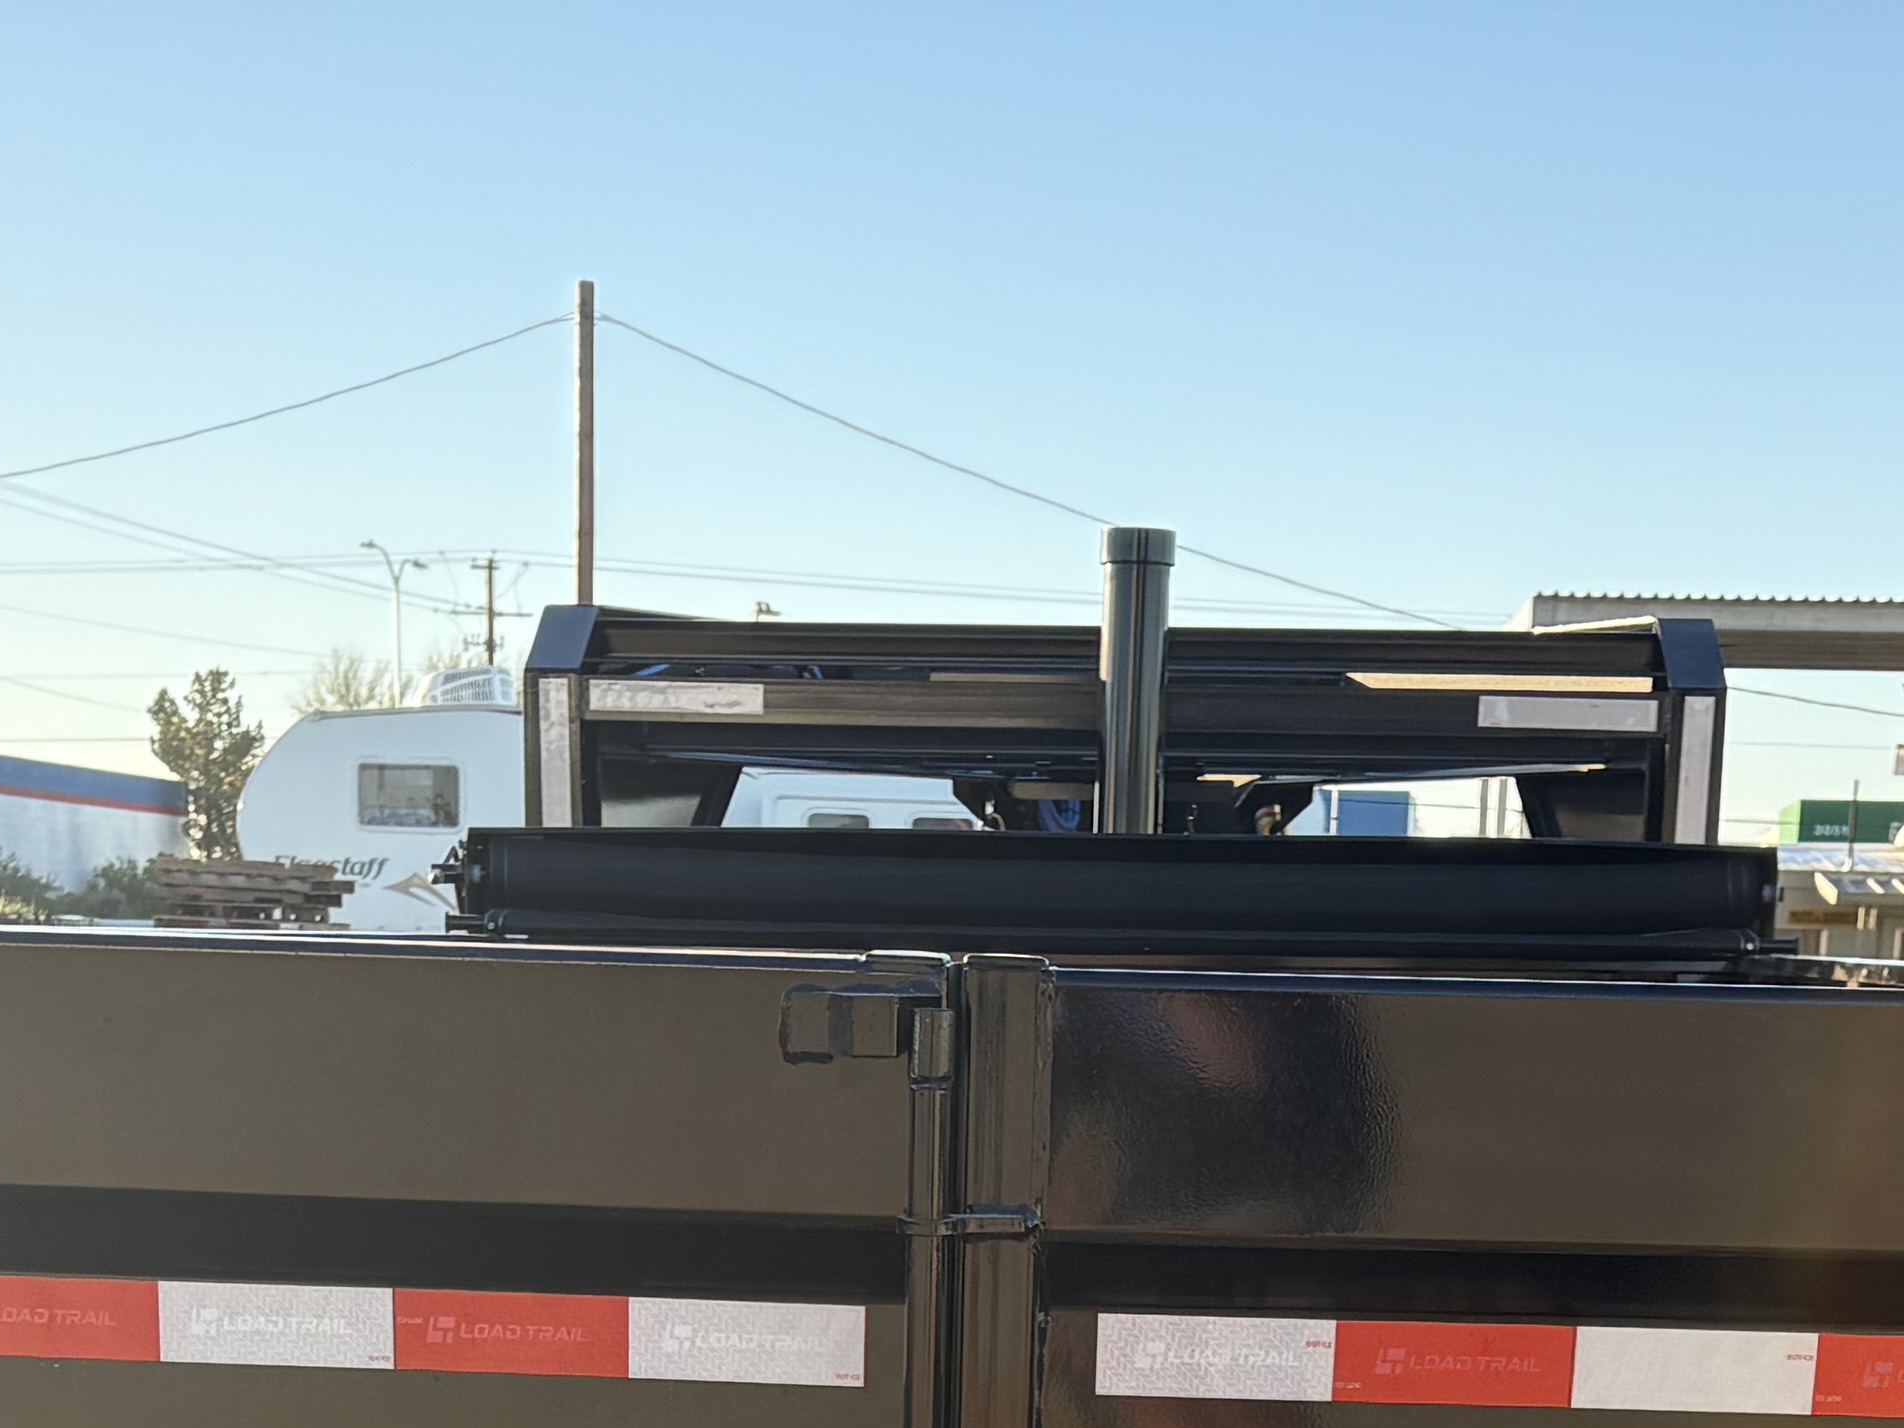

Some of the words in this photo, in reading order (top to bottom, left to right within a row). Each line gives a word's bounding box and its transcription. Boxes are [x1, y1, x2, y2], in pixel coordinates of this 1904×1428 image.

[53, 1309, 117, 1326] TRAIL
[223, 1315, 284, 1332] LOAD
[287, 1317, 353, 1335] TRAIL
[460, 1323, 521, 1340] LOAD
[525, 1325, 589, 1342] TRAIL
[1409, 1354, 1472, 1370] LOAD
[1476, 1356, 1541, 1372] TRAIL
